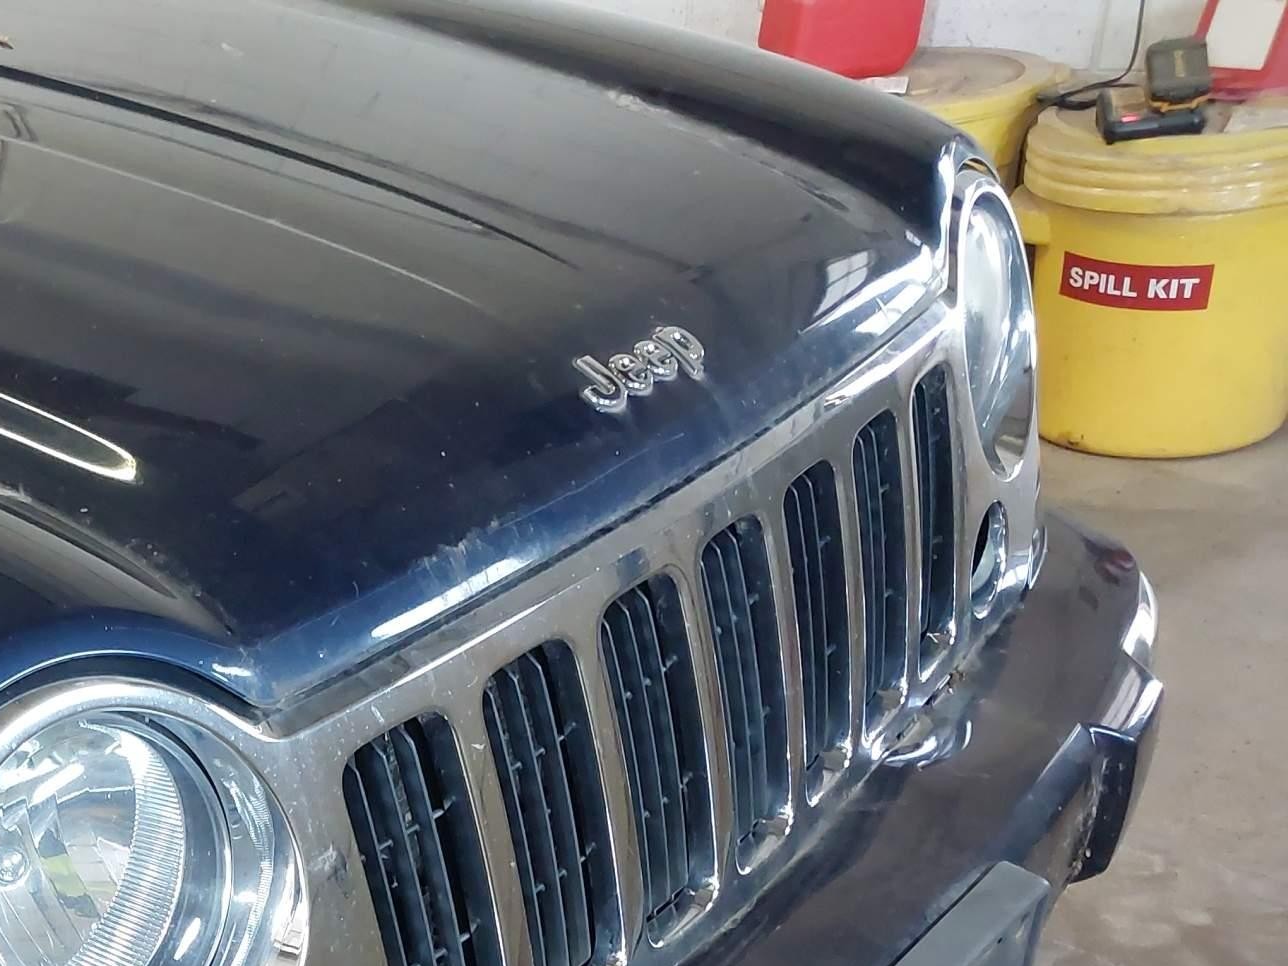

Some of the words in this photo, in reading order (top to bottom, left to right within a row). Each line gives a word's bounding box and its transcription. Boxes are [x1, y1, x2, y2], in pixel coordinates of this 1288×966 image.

[1069, 267, 1138, 298] SPILL
[1147, 278, 1201, 299] KIT
[573, 326, 706, 413] Jeep
